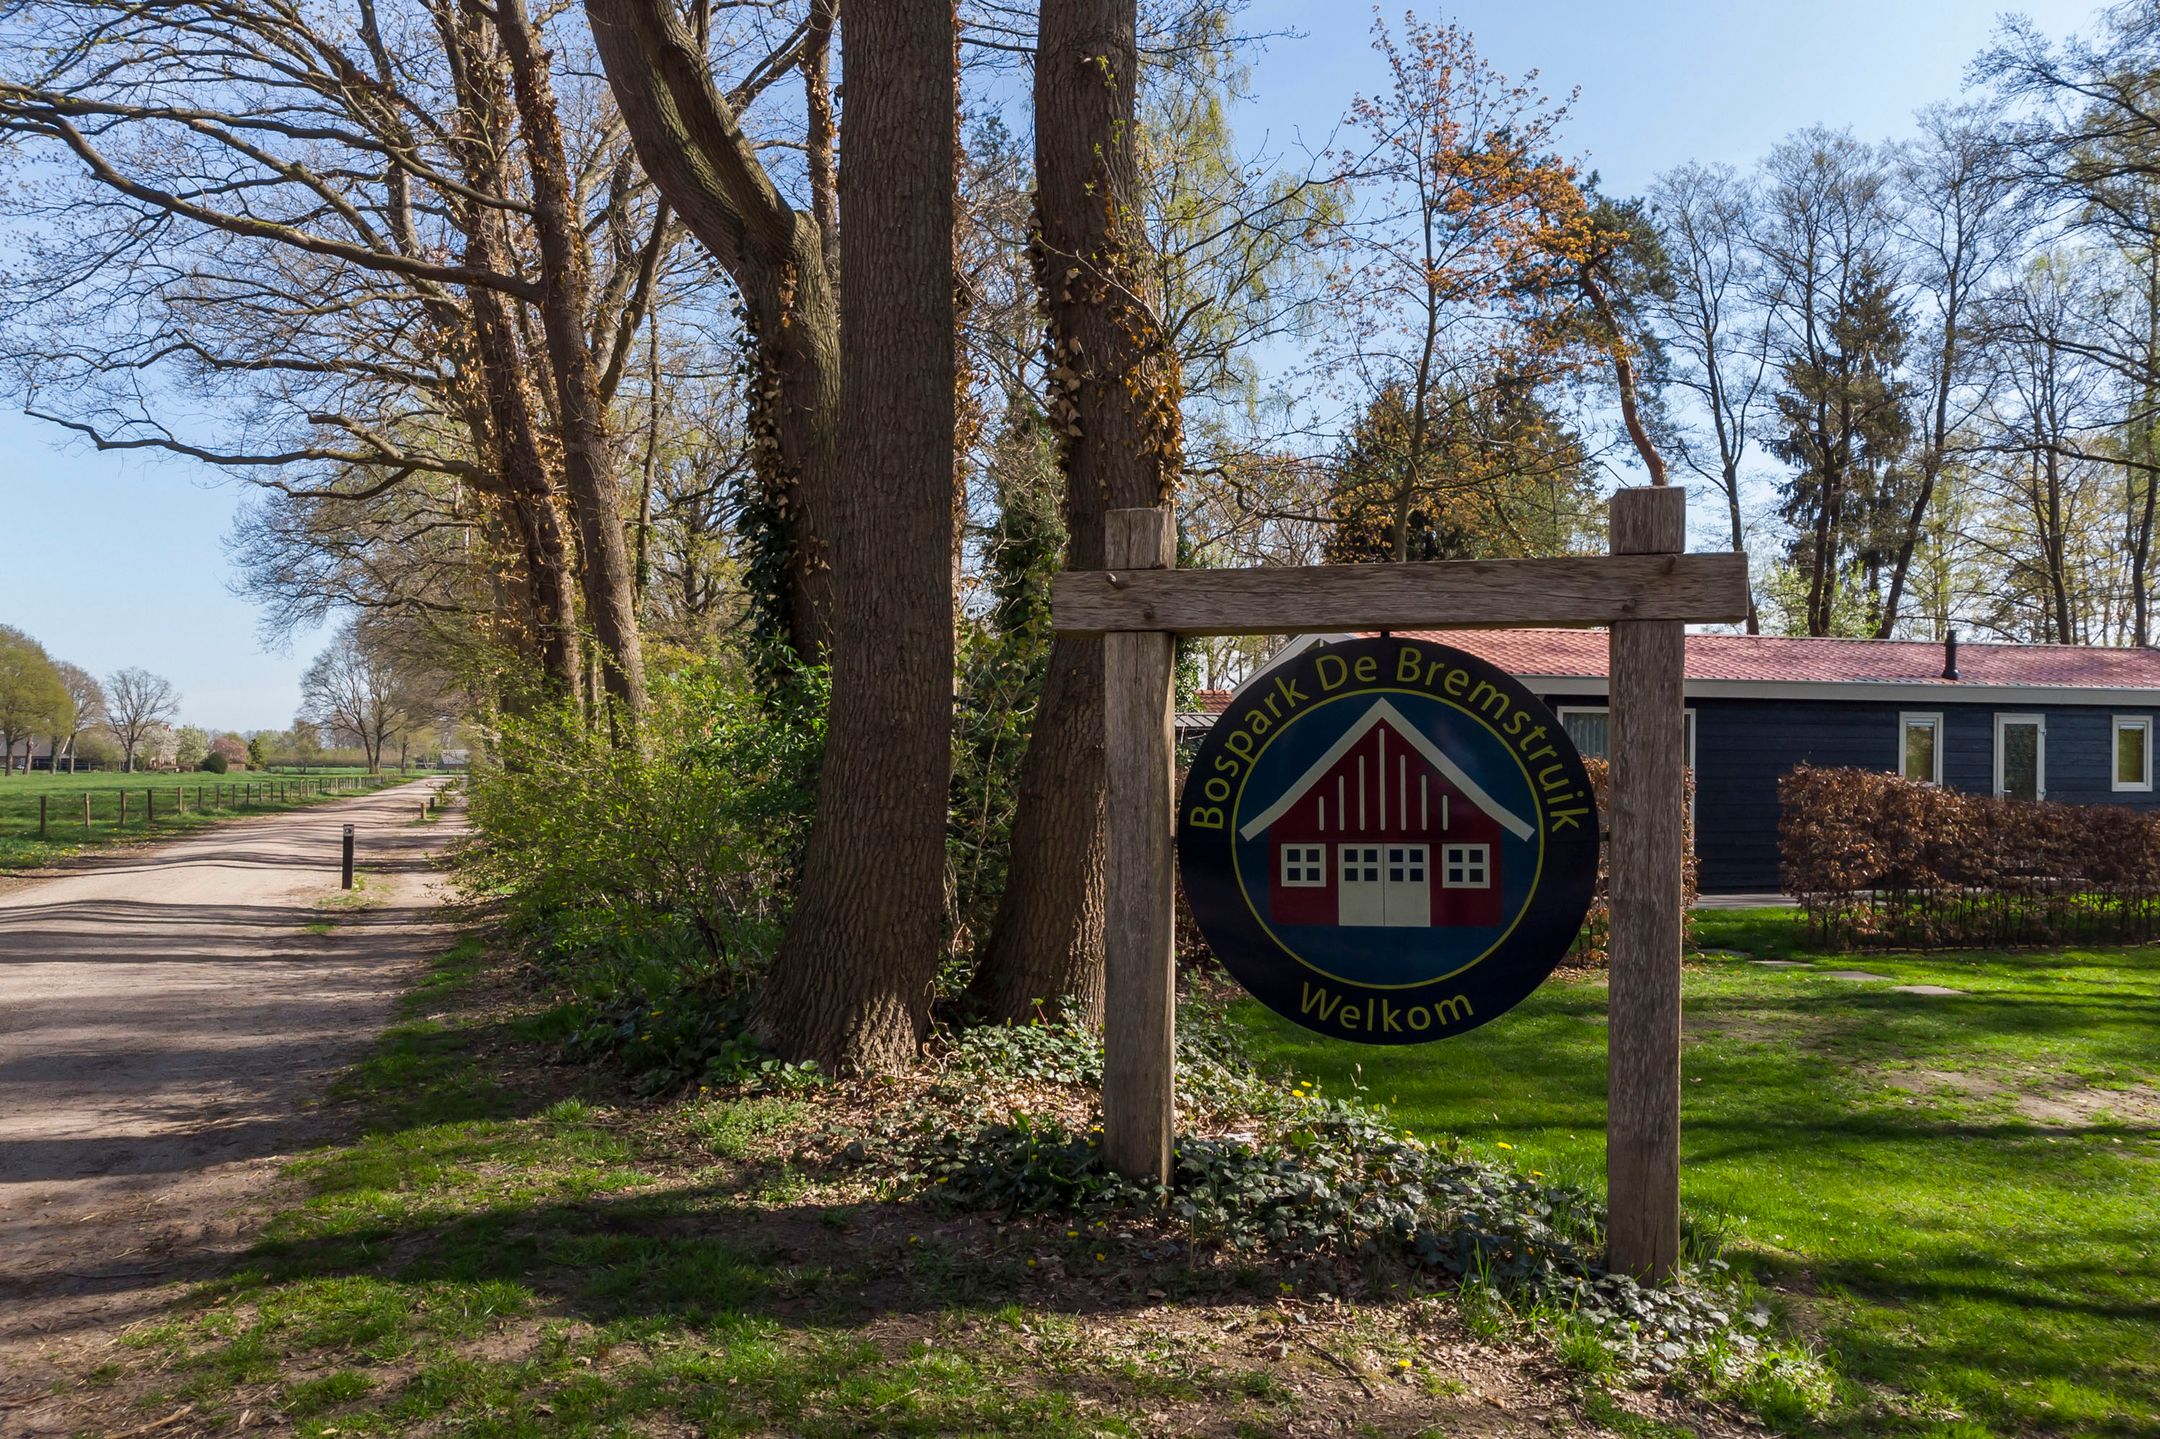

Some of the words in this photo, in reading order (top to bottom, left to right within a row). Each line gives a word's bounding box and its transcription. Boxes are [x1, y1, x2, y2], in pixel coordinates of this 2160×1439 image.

[1190, 677, 1309, 830] Bospark
[1315, 654, 1378, 691] De
[1396, 647, 1590, 832] Bremstruik
[1301, 981, 1474, 1032] Welkom
